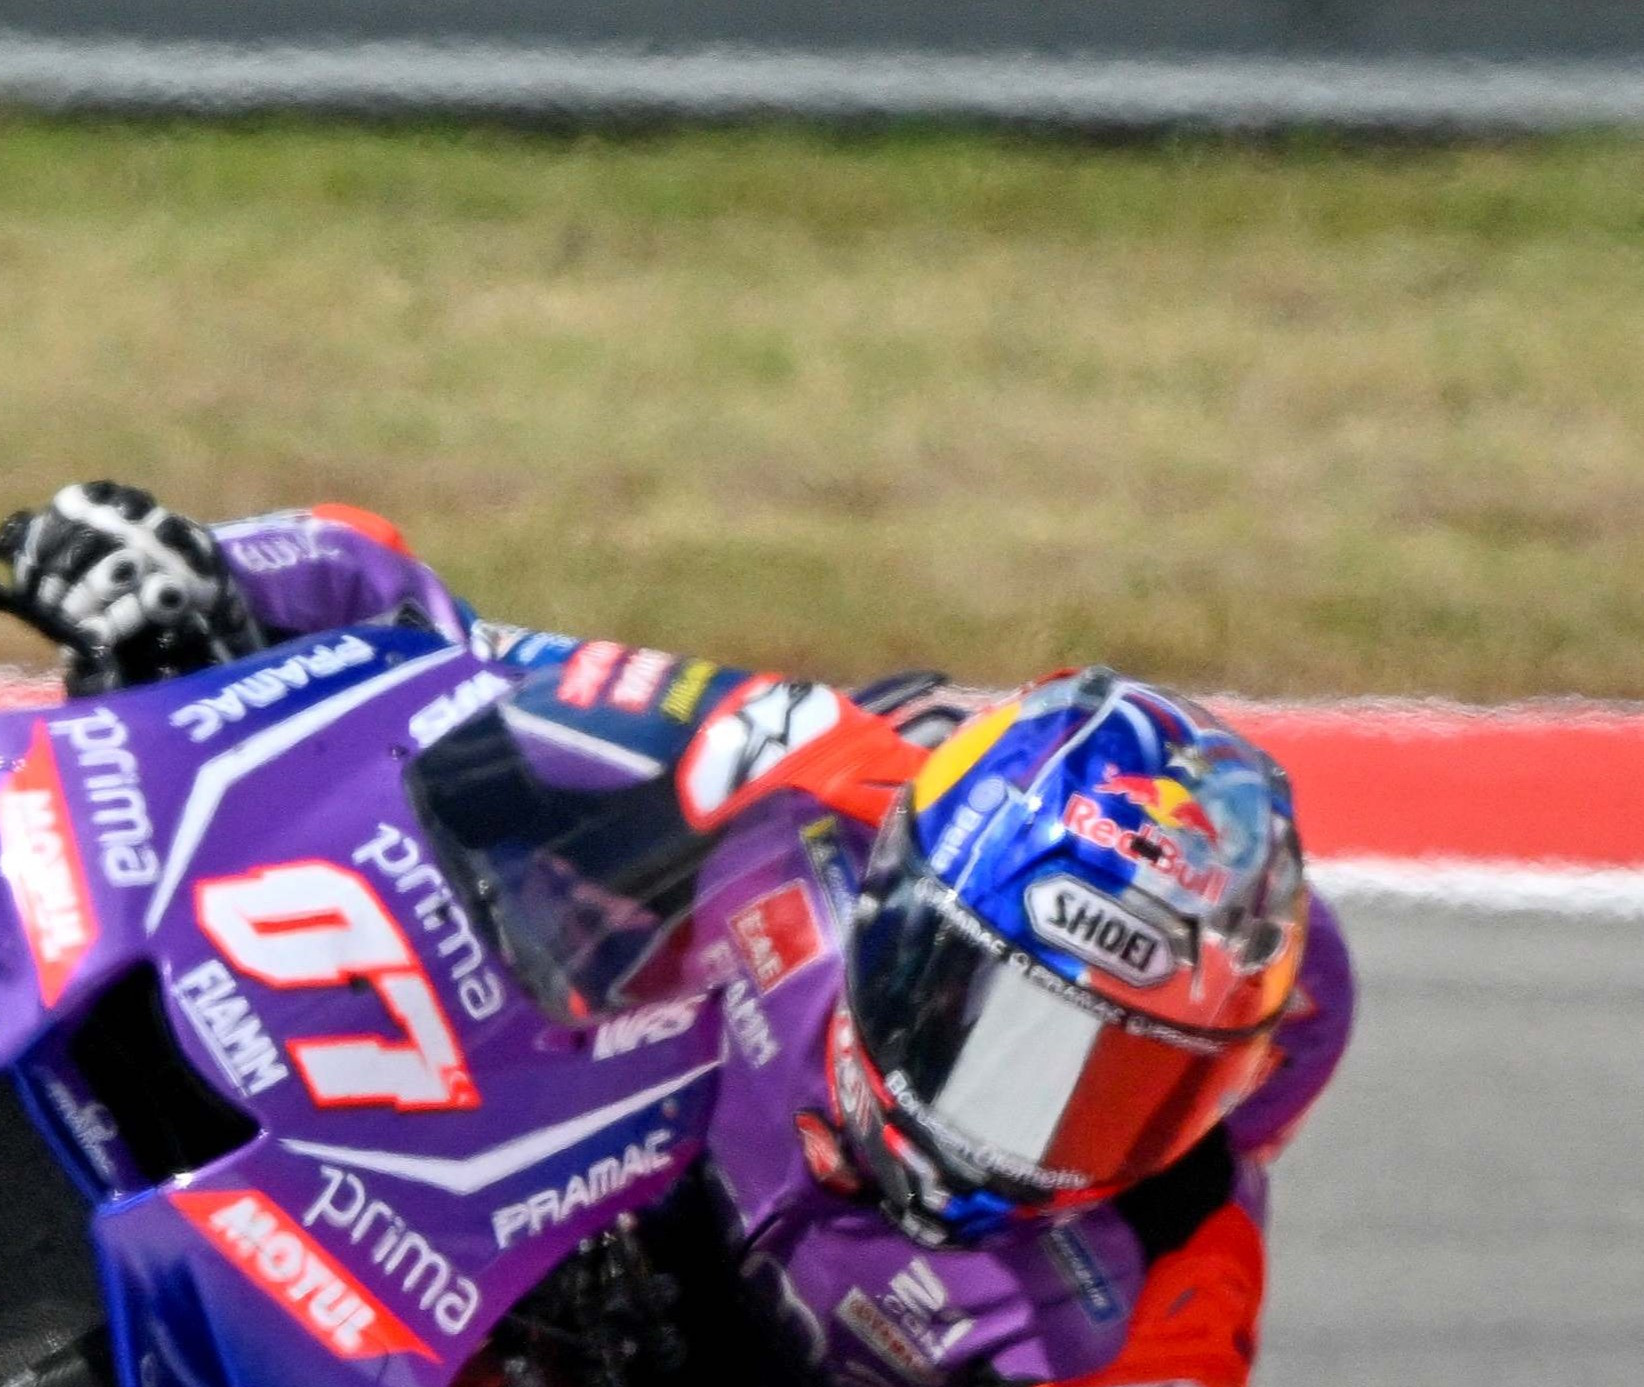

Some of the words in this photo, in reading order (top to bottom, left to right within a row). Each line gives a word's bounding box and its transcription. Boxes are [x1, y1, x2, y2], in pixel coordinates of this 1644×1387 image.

[168, 634, 377, 744] PRAMAC
[48, 707, 161, 889] prima
[1062, 793, 1152, 860] Red
[1152, 838, 1229, 906] Bull
[192, 856, 483, 1114] 07
[352, 822, 505, 1021] prima
[1049, 891, 1159, 974] SHOEI
[177, 959, 288, 1096] FIAMM
[302, 1165, 480, 1336] prima
[490, 1128, 673, 1250] PRAMAC
[209, 1194, 380, 1357] MOTUL
